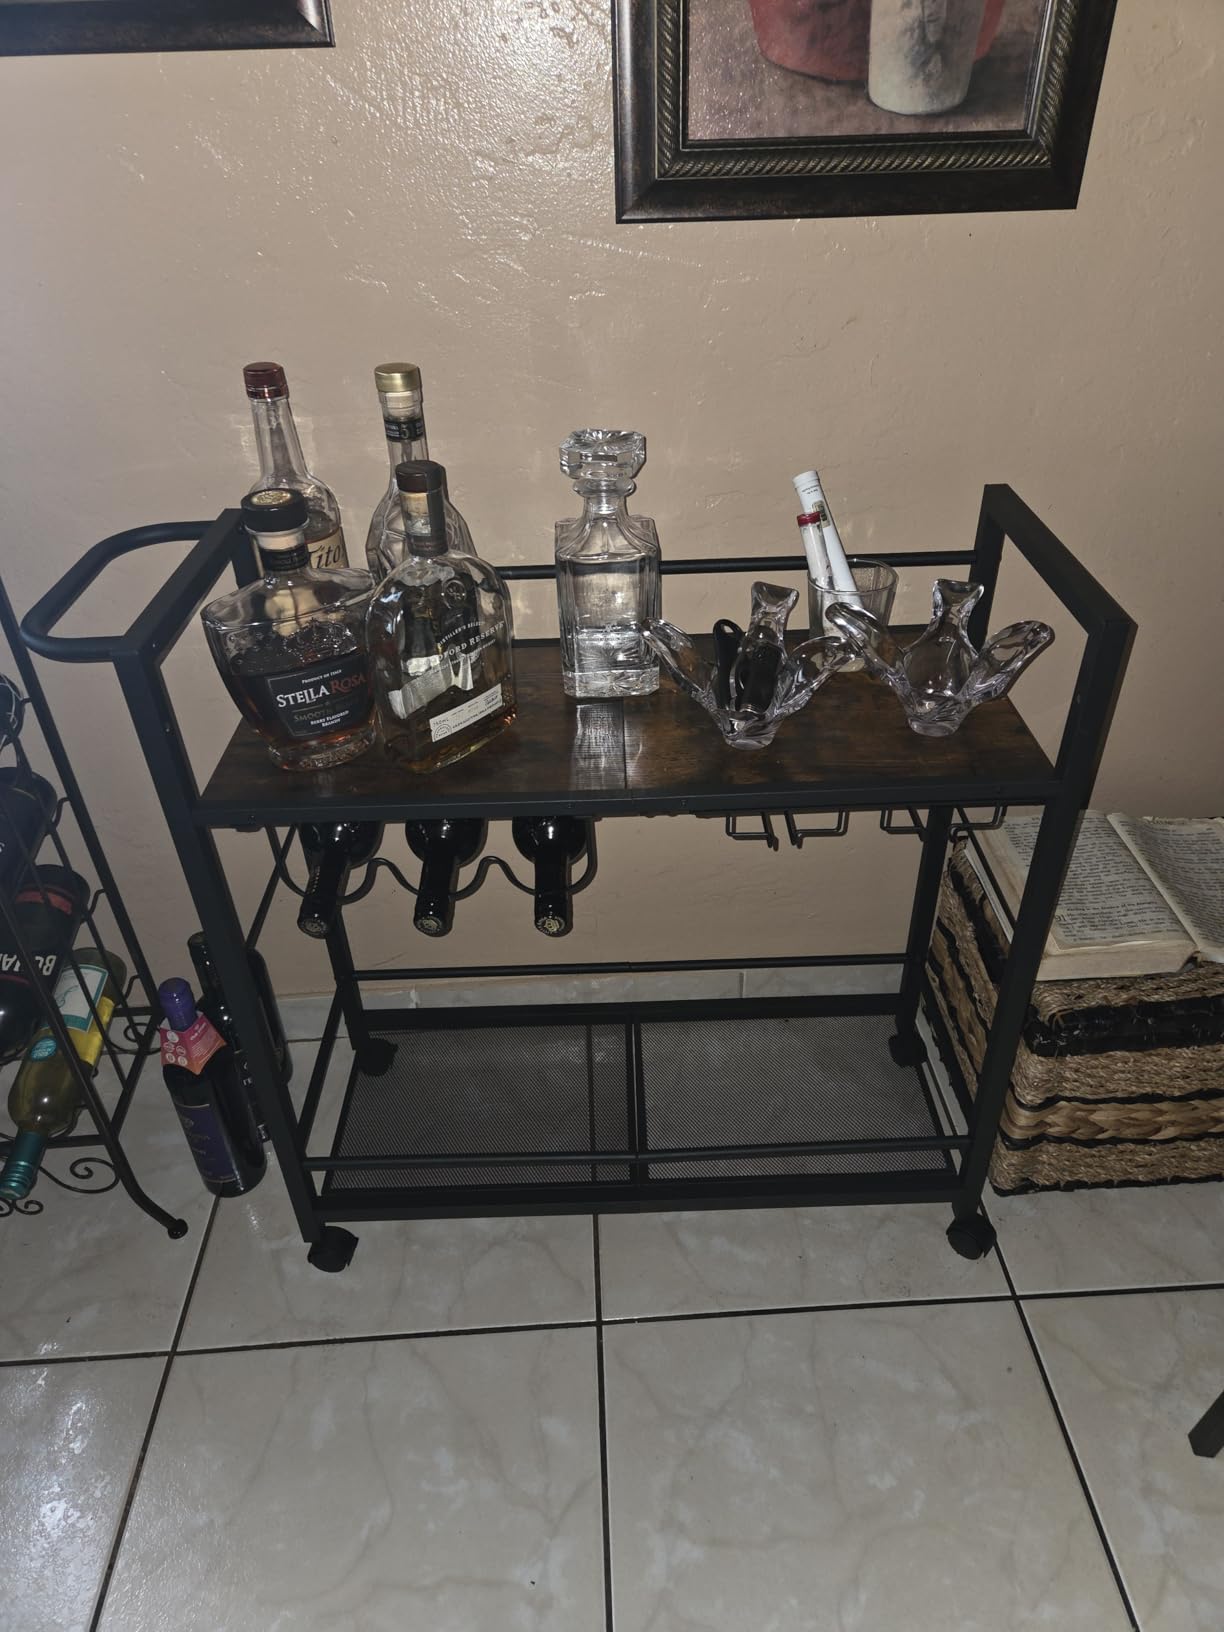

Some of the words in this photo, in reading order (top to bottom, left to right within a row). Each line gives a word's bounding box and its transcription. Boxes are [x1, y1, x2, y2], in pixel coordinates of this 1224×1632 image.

[469, 620, 504, 645] RESERVE
[276, 684, 330, 708] STELLA
[330, 673, 366, 695] ROSA
[301, 675, 323, 684] PRODUCT
